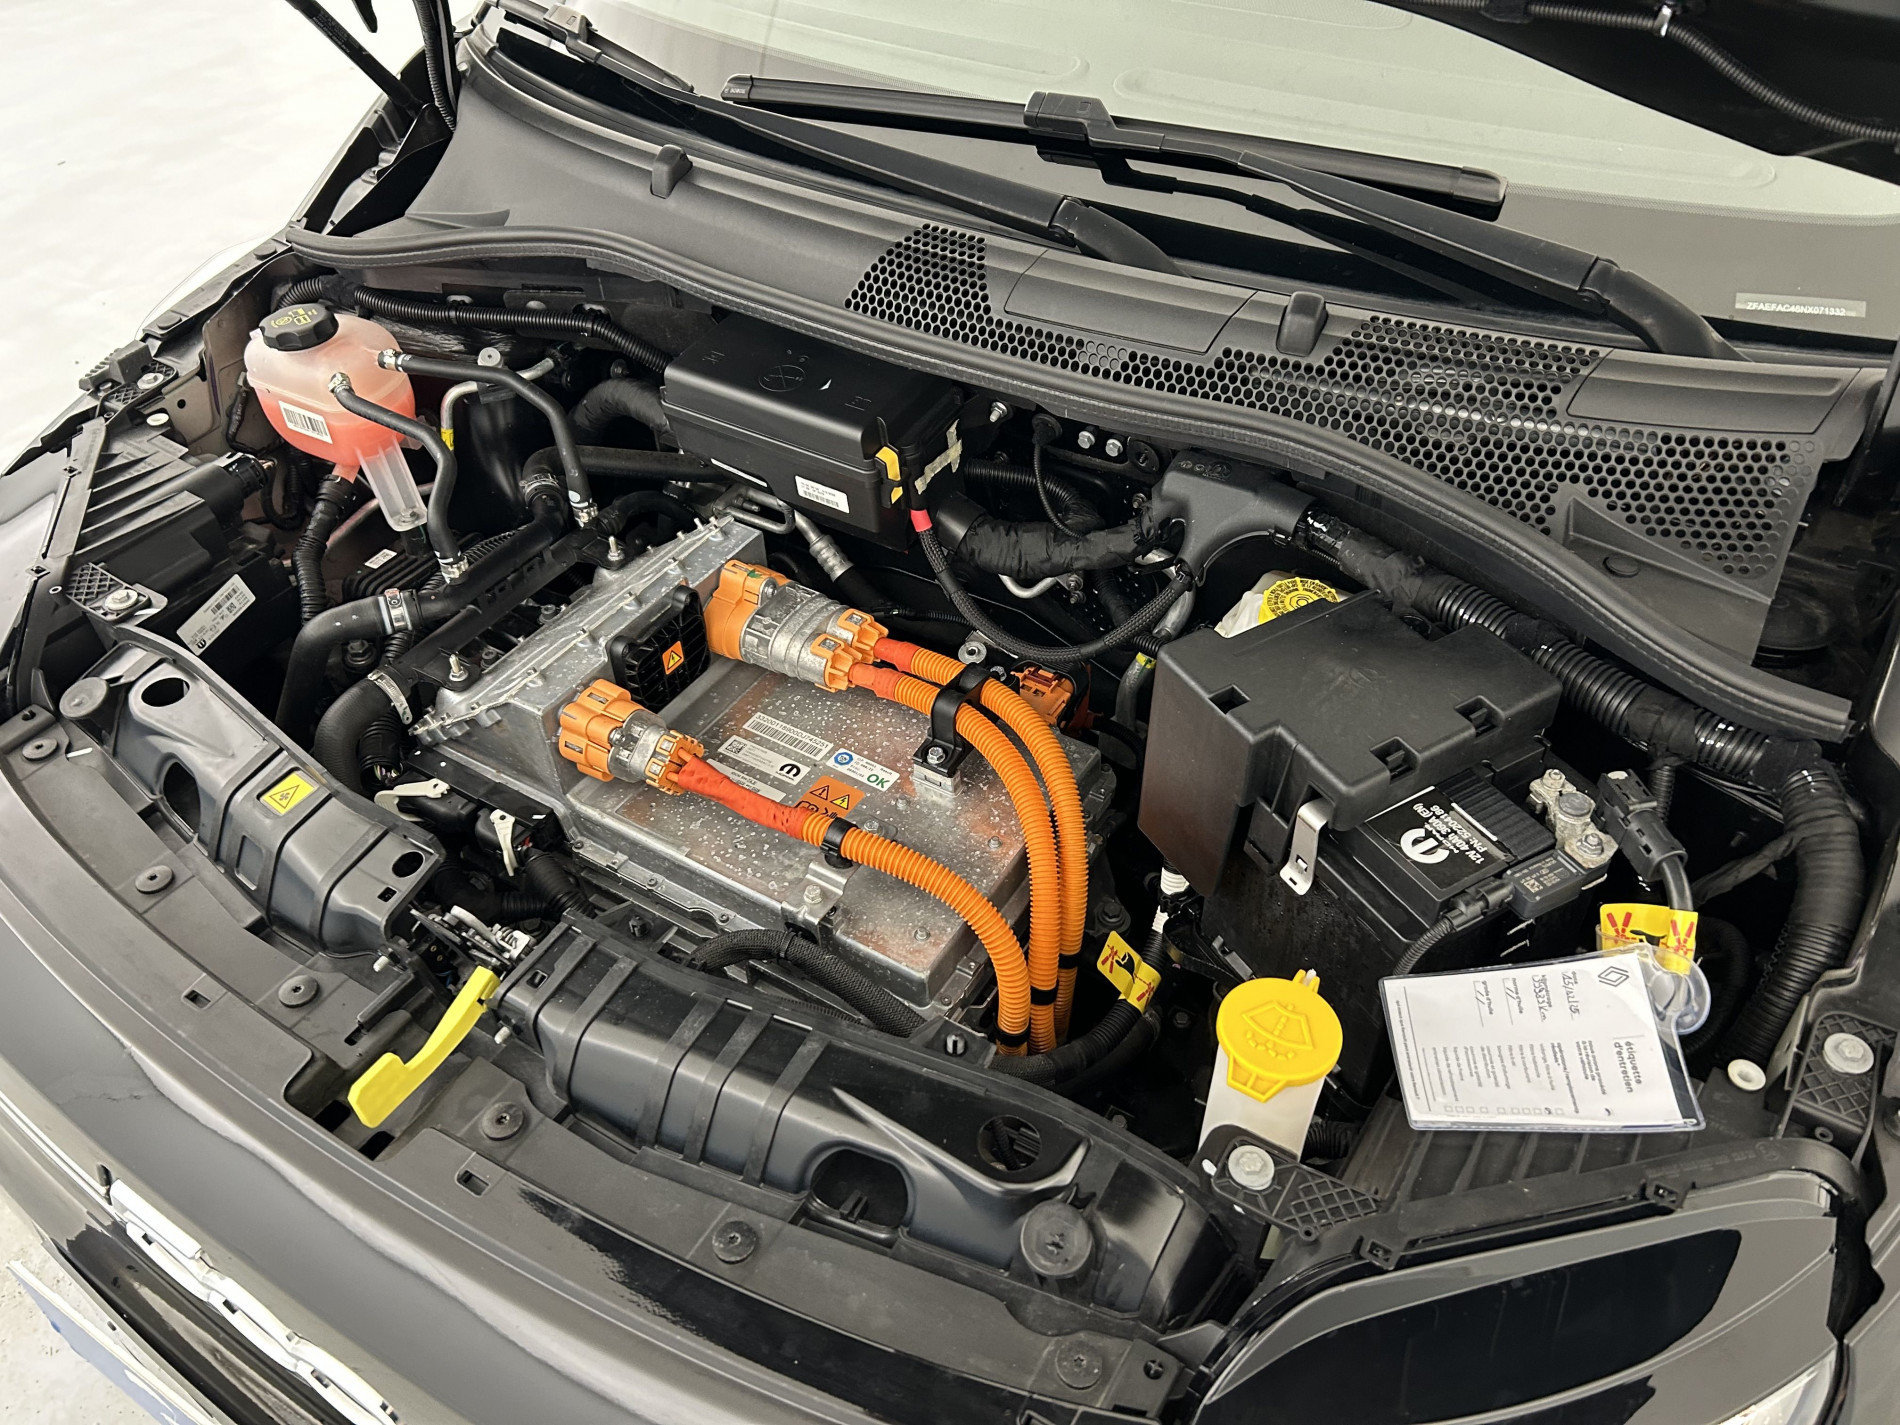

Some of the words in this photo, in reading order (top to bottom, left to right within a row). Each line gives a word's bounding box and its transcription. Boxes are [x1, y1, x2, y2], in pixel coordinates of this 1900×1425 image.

[864, 772, 890, 788] OK
[1412, 800, 1433, 819] (EN)
[1427, 815, 1451, 836] 360A
[1429, 803, 1471, 839] 52204186
[1446, 831, 1470, 853] 40Ah
[1467, 835, 1487, 853] PN:
[1465, 847, 1484, 864] 12V
[1481, 980, 1489, 996] grade
[1511, 977, 1519, 994] norme
[1613, 1041, 1634, 1092] d'entretien
[1622, 1040, 1644, 1084] étiquette
